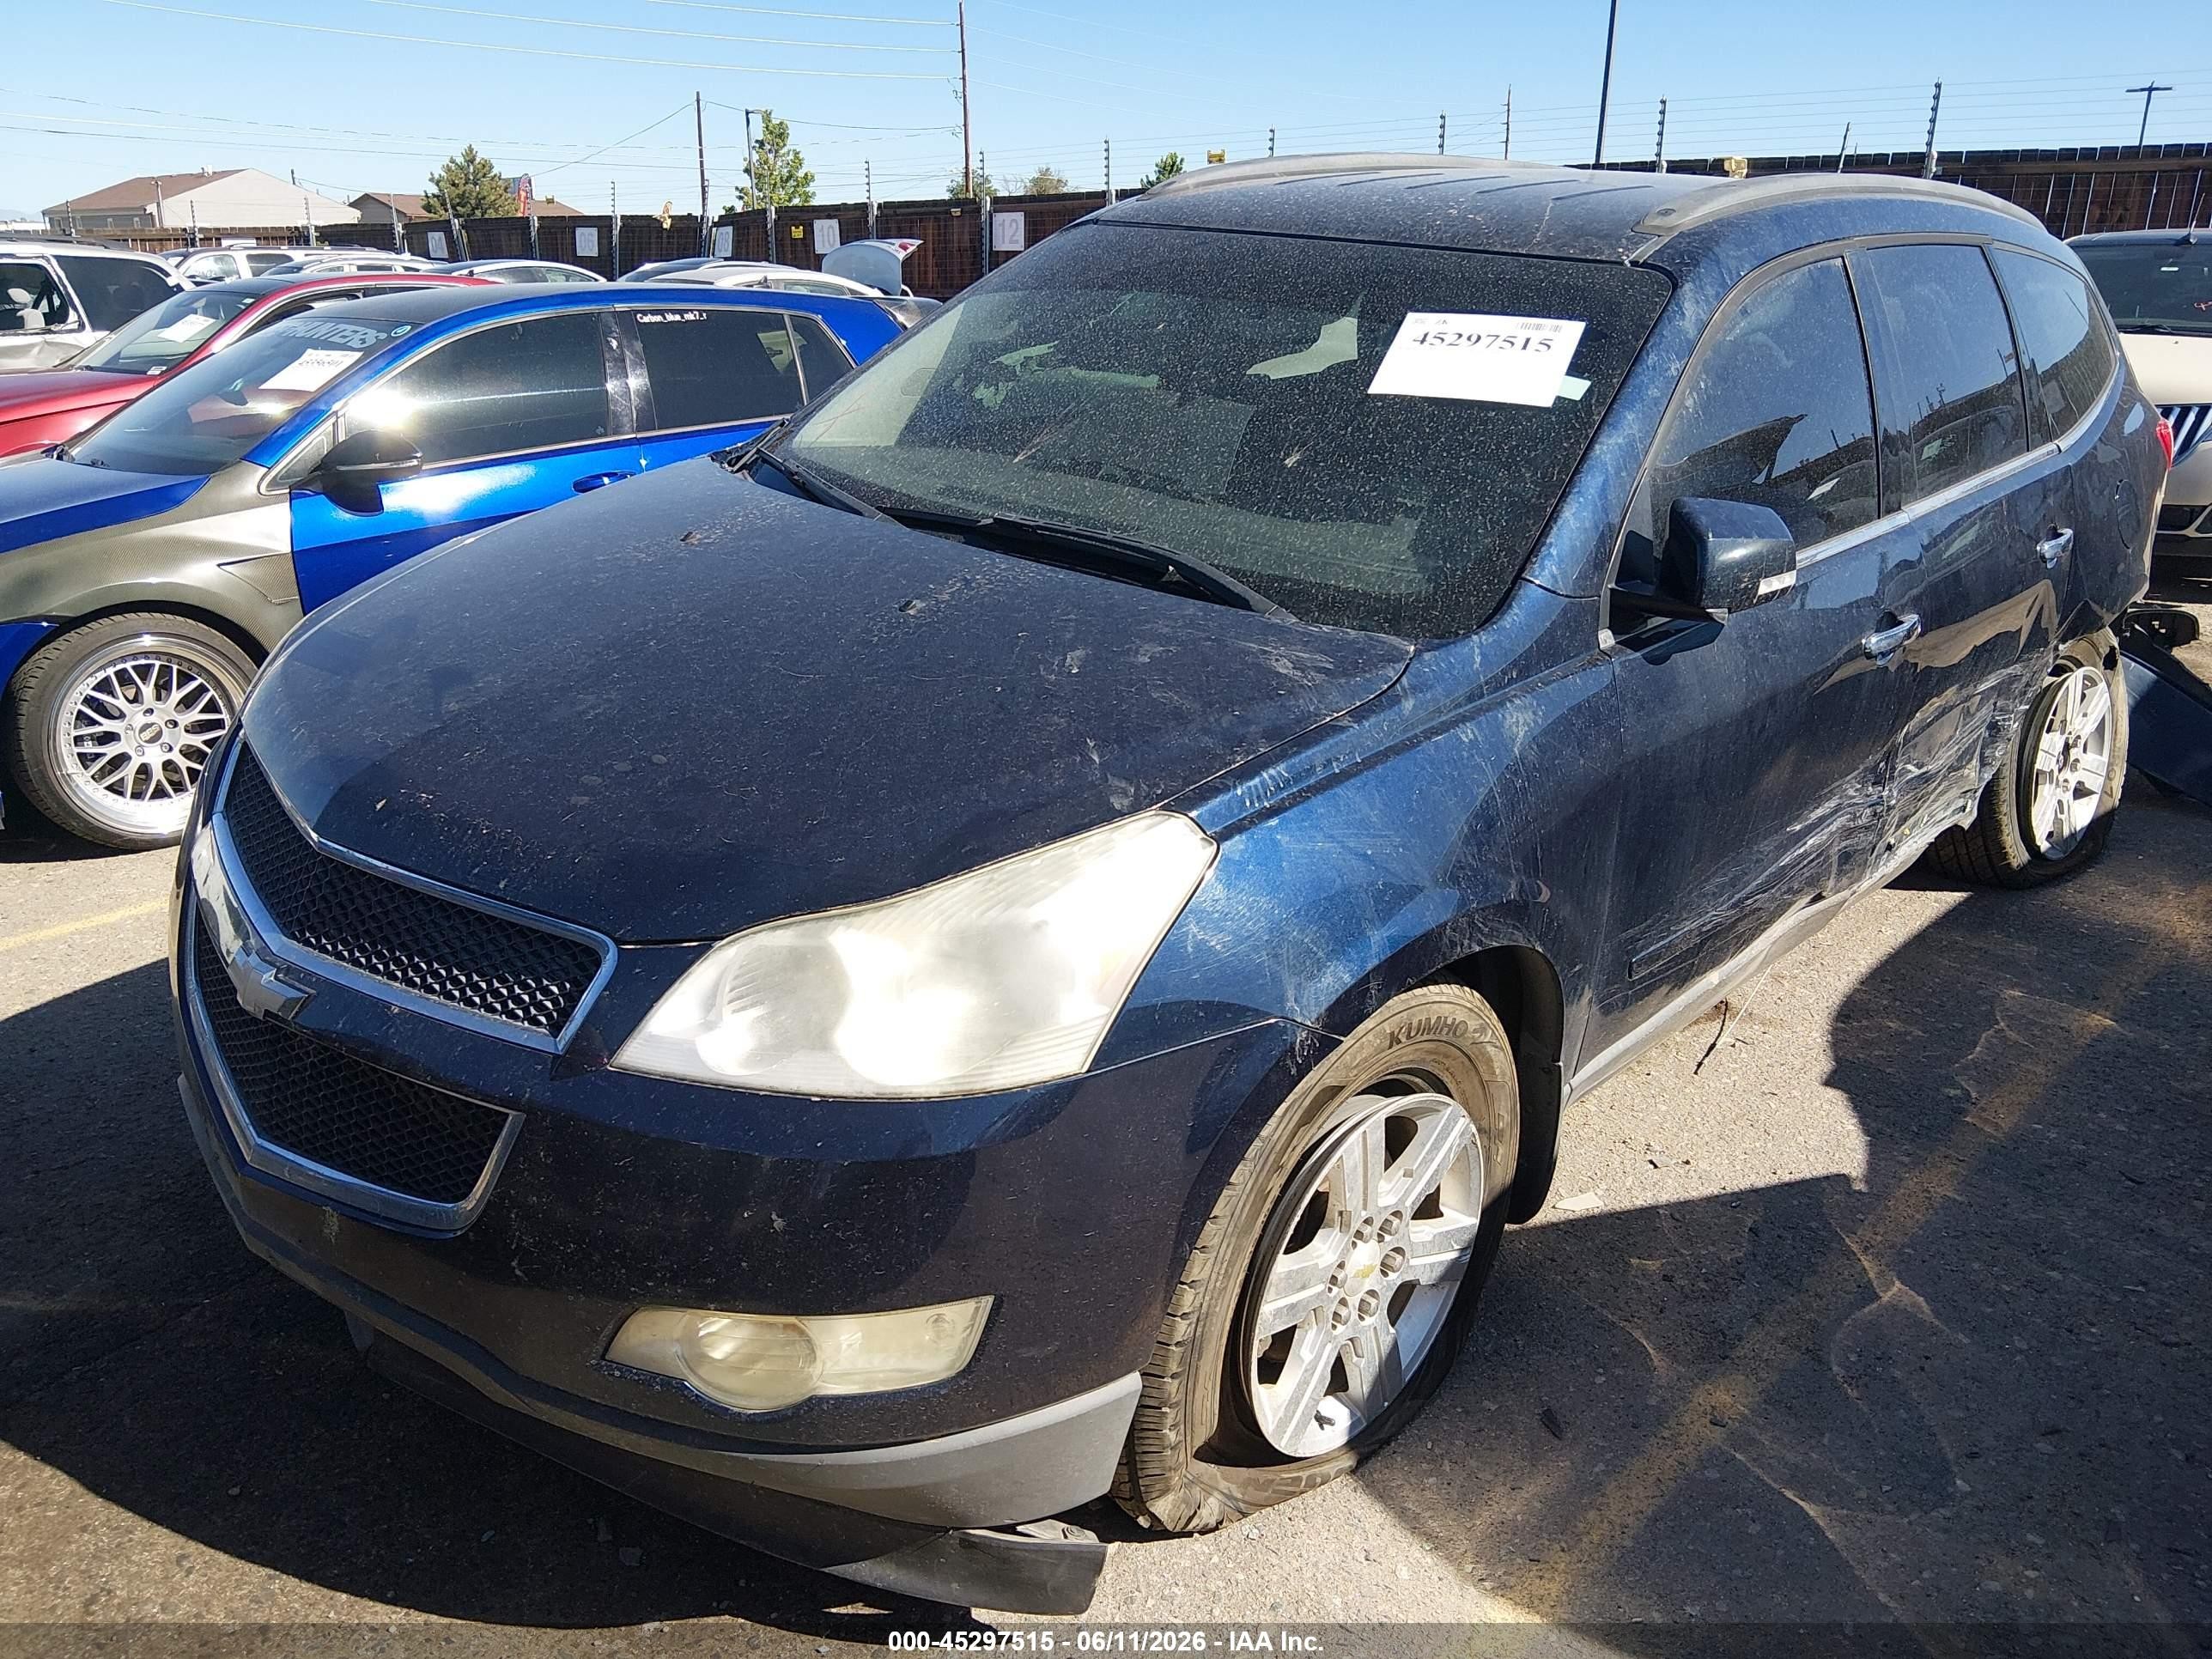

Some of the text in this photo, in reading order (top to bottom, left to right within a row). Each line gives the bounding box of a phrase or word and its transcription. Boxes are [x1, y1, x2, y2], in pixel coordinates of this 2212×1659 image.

[579, 232, 594, 252] 06
[818, 223, 837, 249] 10
[999, 219, 1019, 245] 12
[431, 235, 445, 254] 04
[1413, 331, 1554, 352] 45297515
[140, 724, 161, 741] BBS
[1387, 1016, 1468, 1050] KUMHO
